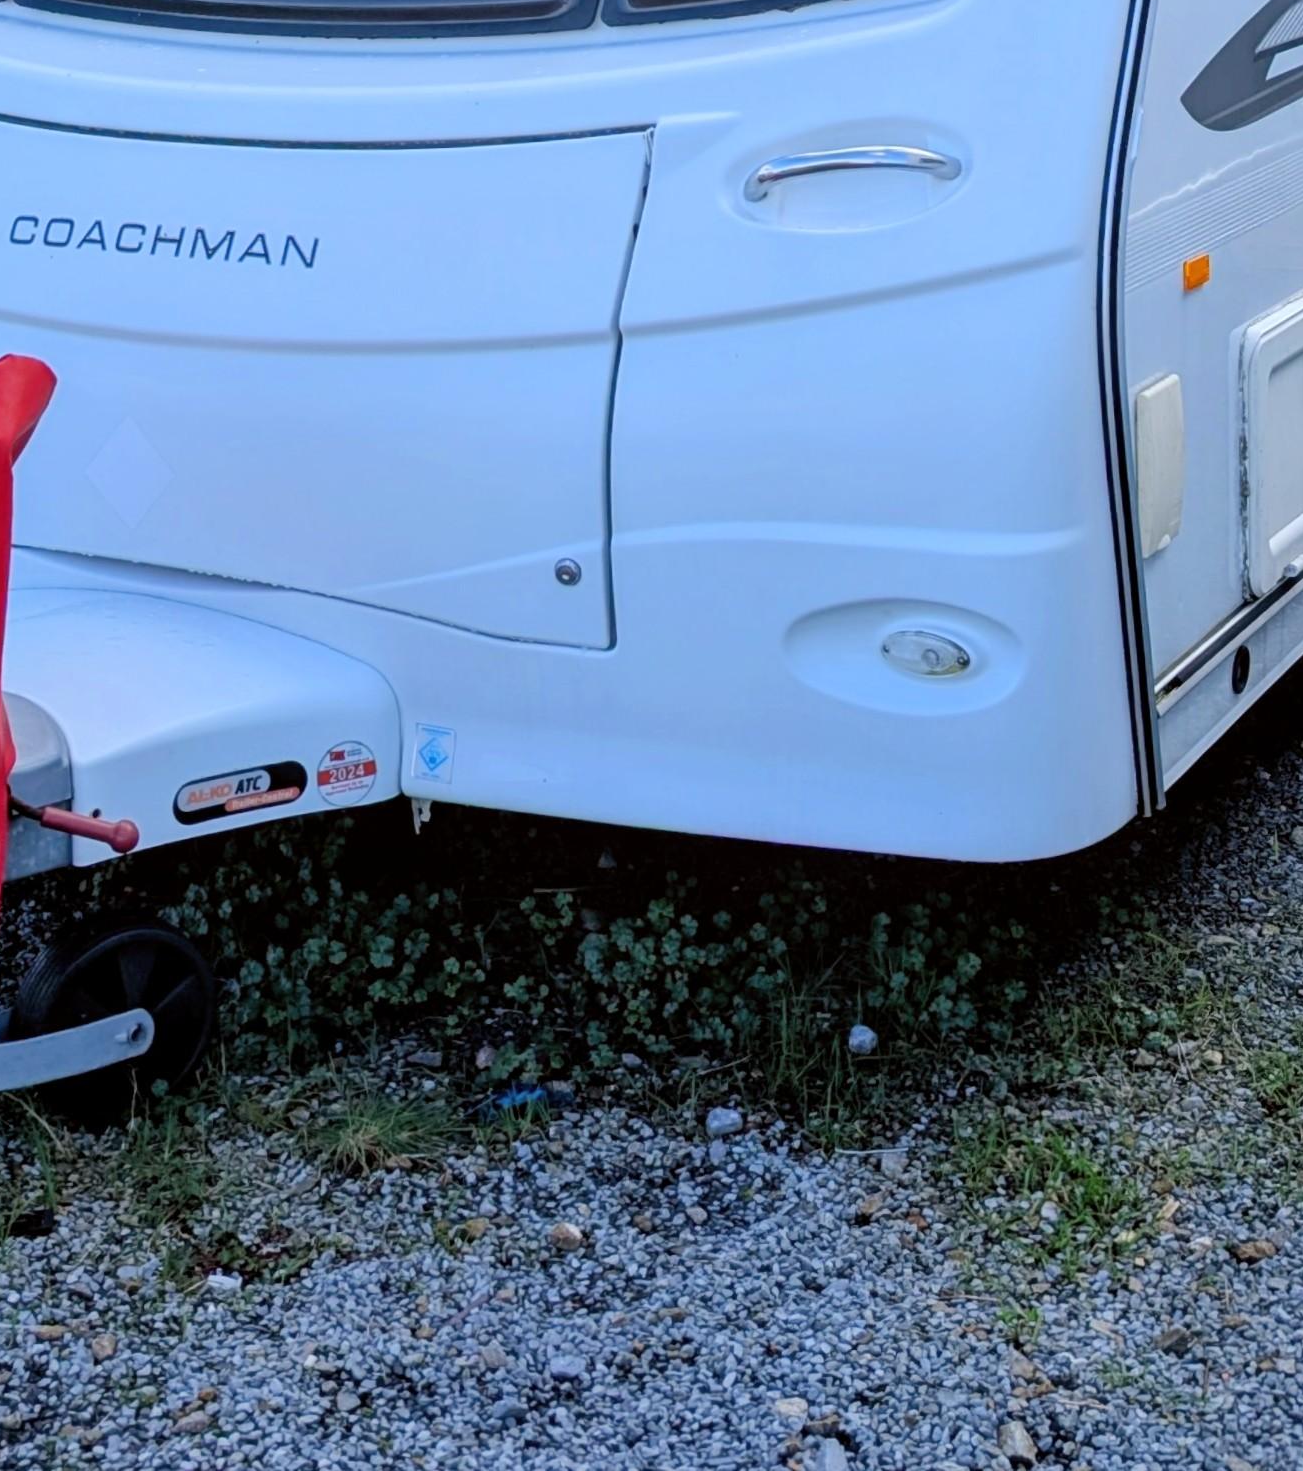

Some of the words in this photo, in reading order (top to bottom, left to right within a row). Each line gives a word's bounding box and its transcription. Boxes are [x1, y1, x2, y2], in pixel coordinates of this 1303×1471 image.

[9, 215, 320, 269] COACHMAN
[329, 763, 365, 784] 2024
[235, 775, 263, 795] ATC
